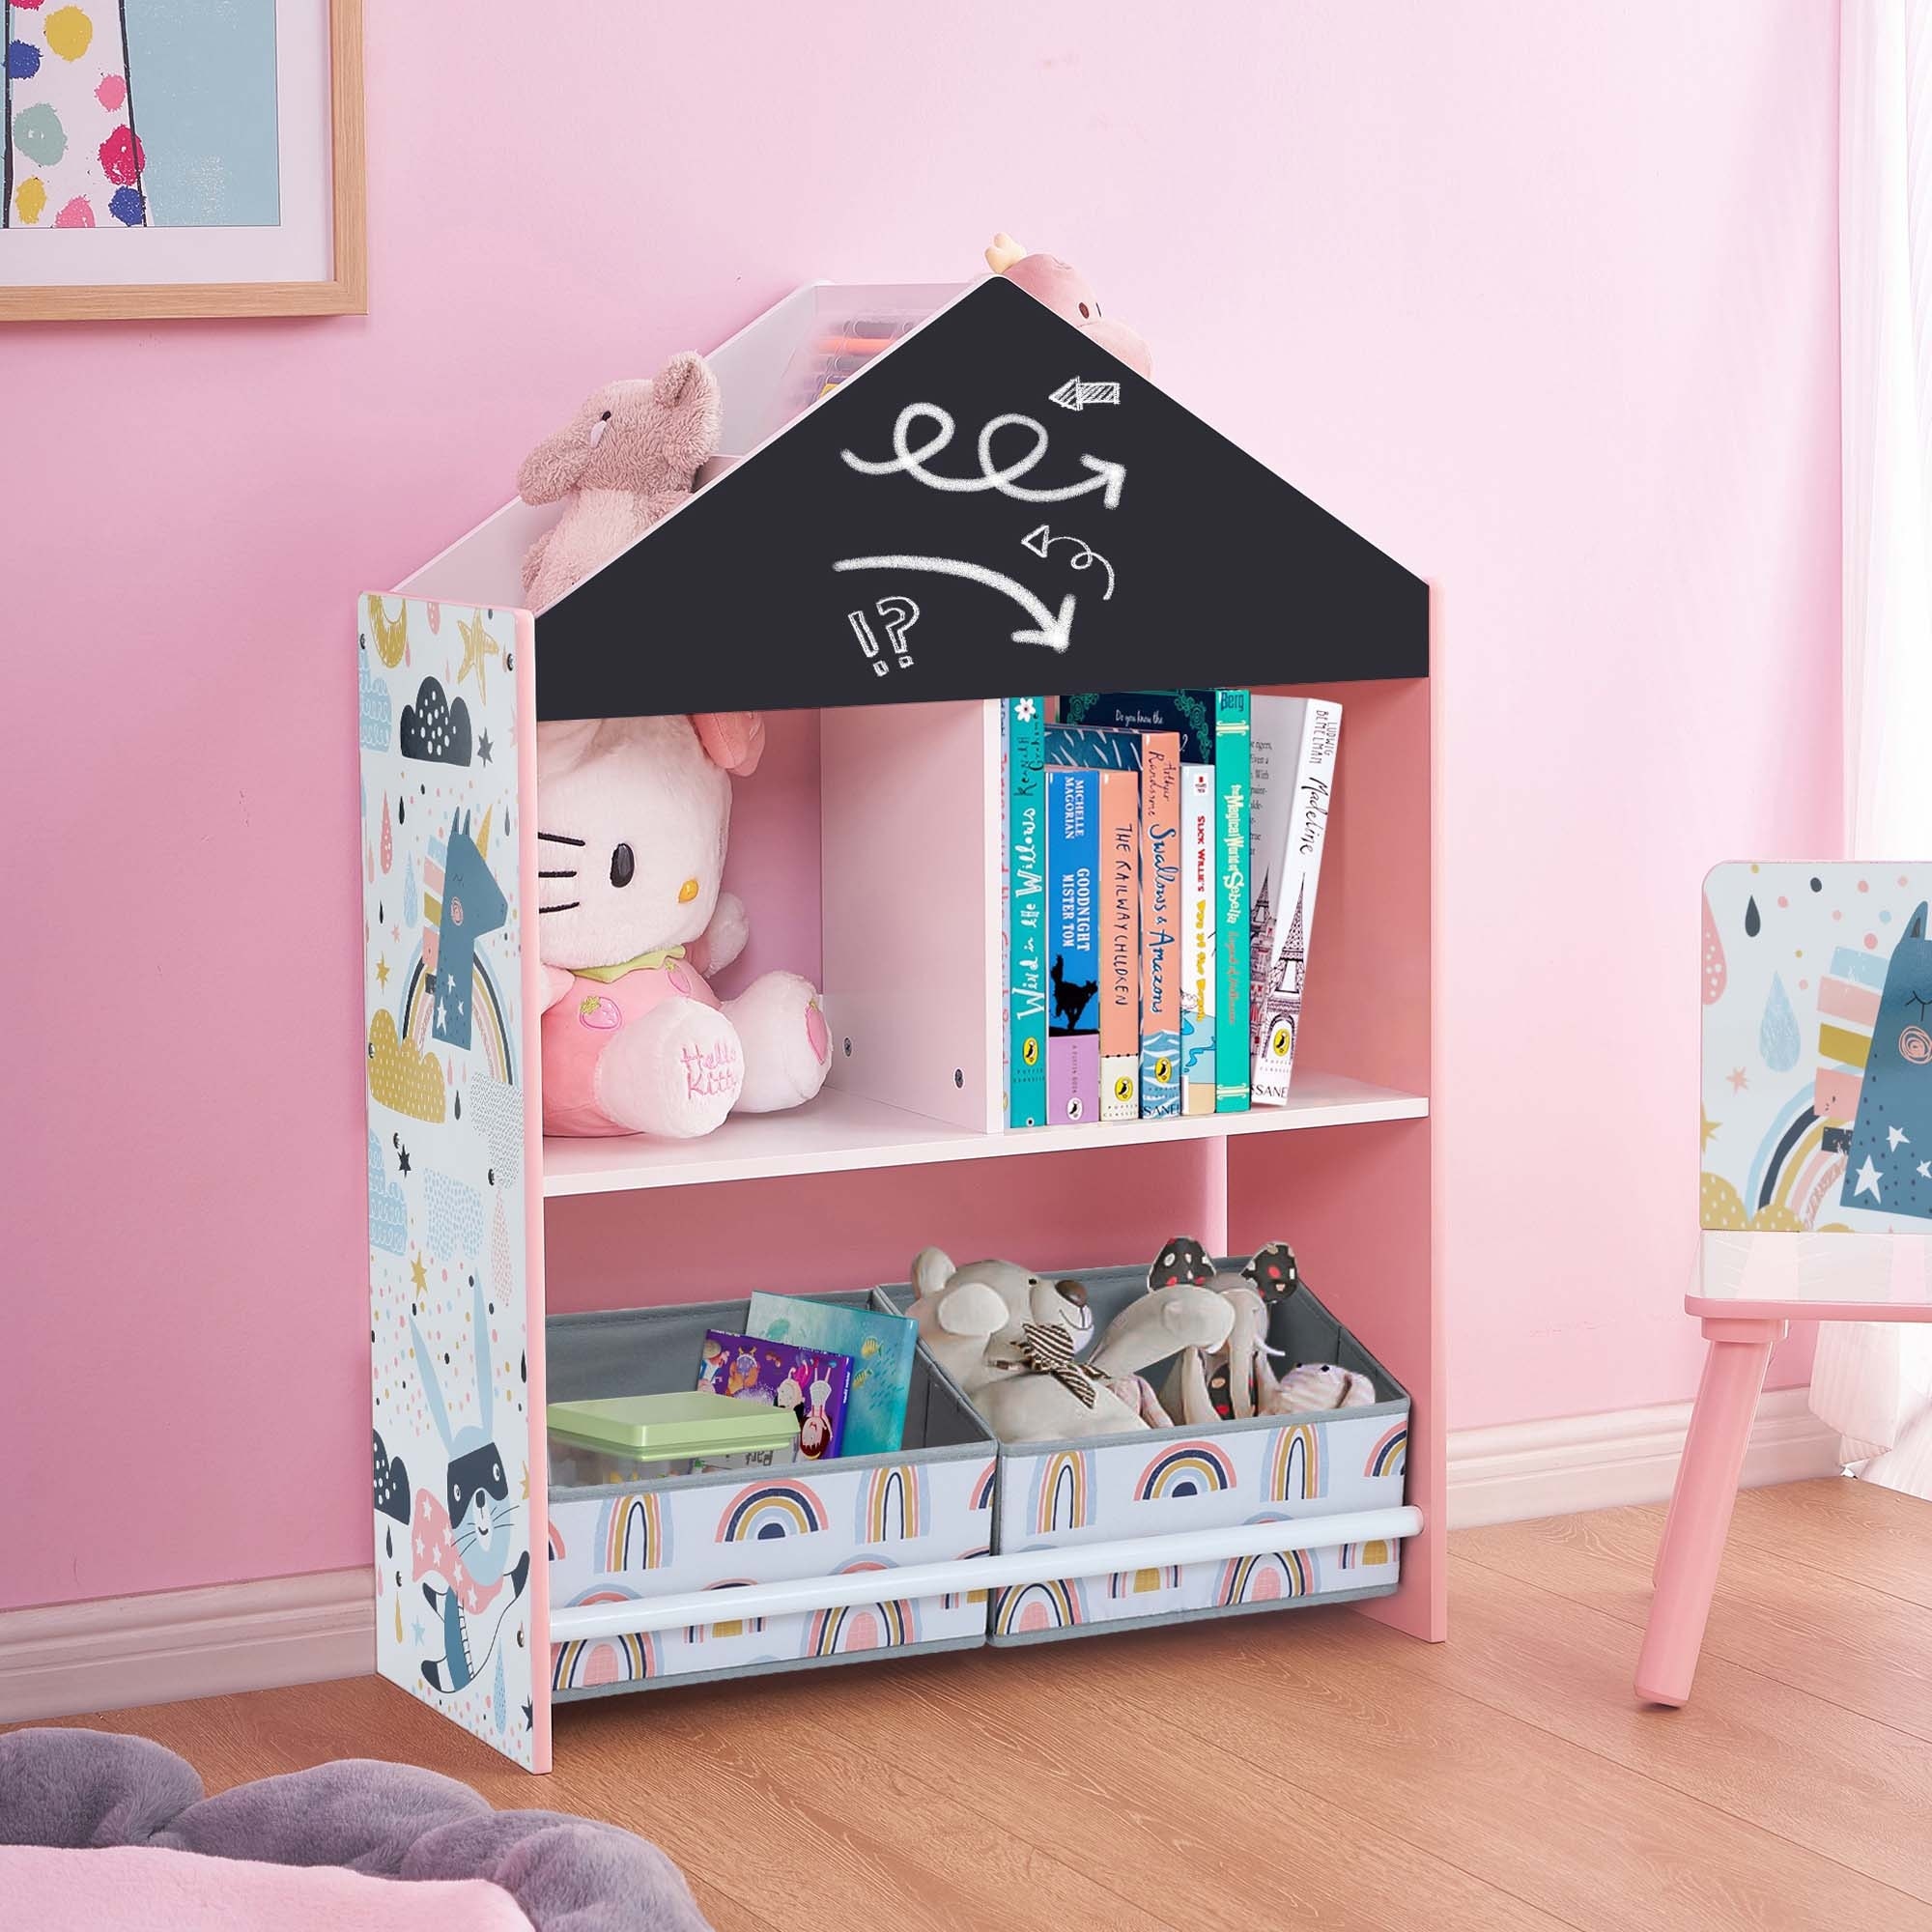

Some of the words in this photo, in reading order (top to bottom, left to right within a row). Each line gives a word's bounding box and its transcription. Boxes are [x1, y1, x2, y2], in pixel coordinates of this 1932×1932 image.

[1323, 722, 1337, 756] LUDWIG
[1065, 776, 1075, 839] MAGORIAN
[1074, 780, 1085, 837] MICHELLE
[1115, 822, 1133, 853] THE
[1299, 777, 1329, 856] Madeline
[1014, 808, 1043, 898] Willows
[1148, 823, 1179, 913] Swallows
[1062, 873, 1074, 921] MISTER
[1076, 867, 1091, 952] GOODNIGHT
[1114, 860, 1132, 931] RAILWAY
[1062, 923, 1074, 949] TOM
[1113, 934, 1129, 1007] CHILDREN
[1148, 928, 1176, 1014] Amazons
